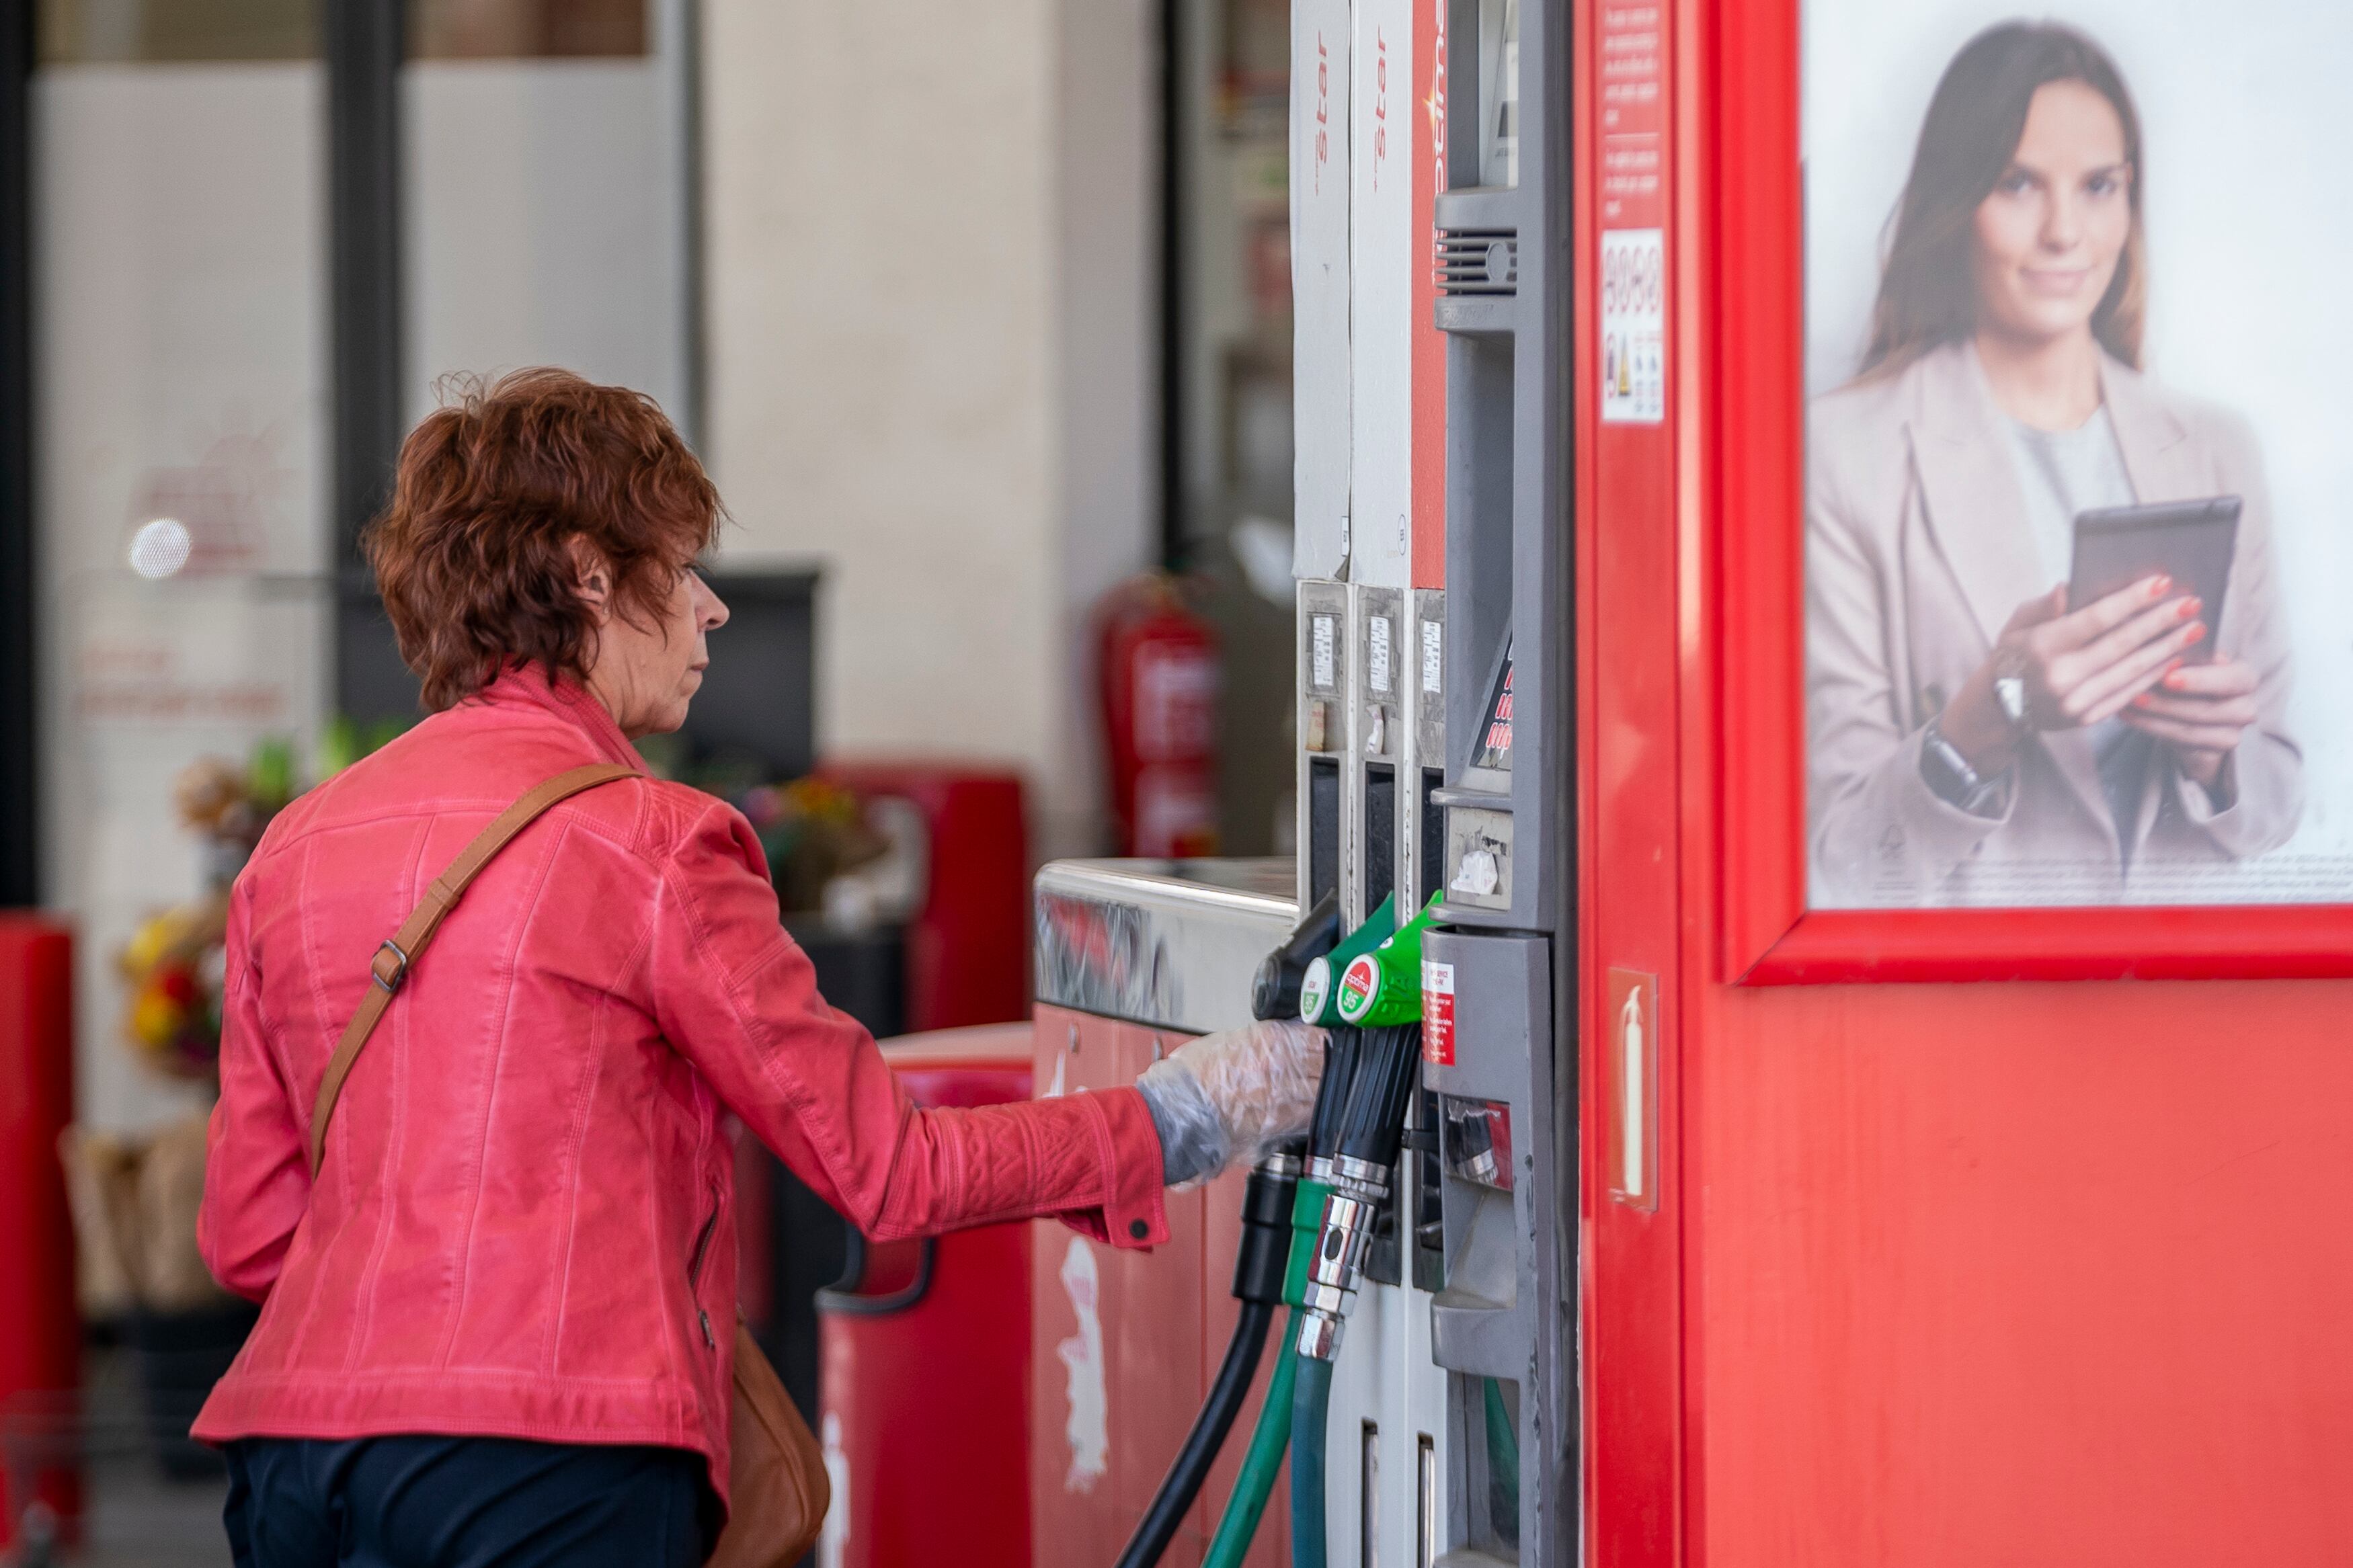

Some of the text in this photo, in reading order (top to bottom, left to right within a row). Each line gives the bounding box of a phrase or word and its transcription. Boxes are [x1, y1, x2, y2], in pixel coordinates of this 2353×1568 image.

[1316, 29, 1328, 163] star
[1375, 24, 1386, 161] star
[1343, 991, 1359, 1009] 95
[1347, 973, 1369, 993] optima
